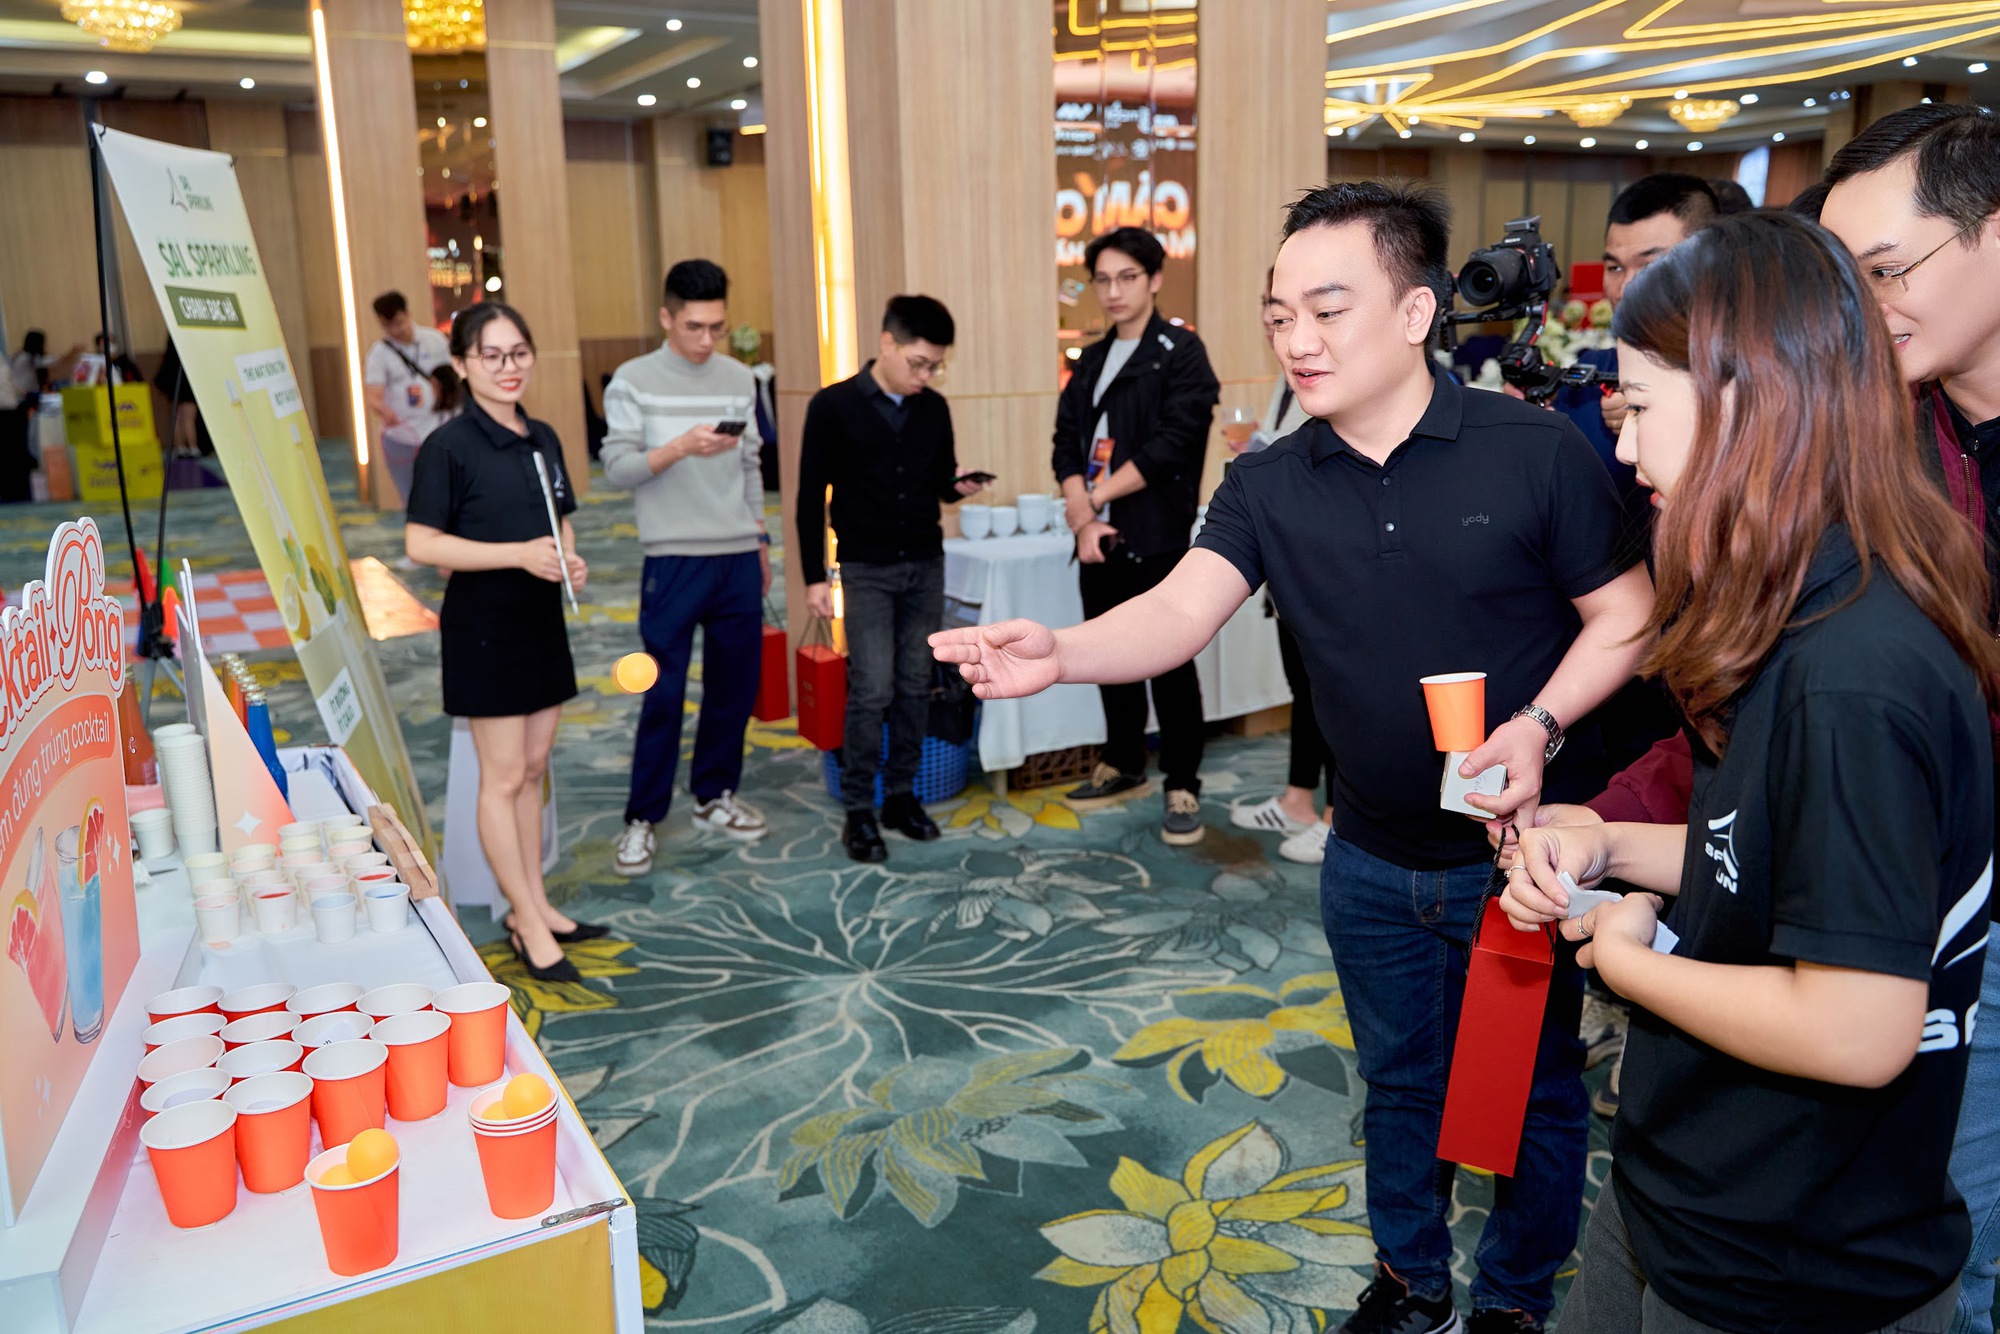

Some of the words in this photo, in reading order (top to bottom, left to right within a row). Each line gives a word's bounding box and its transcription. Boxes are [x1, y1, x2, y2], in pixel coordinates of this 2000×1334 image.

[158, 242, 193, 278] SAL
[187, 242, 257, 278] SPARKLING
[1461, 512, 1489, 527] yody
[56, 534, 120, 683] Pong
[12, 756, 42, 821] đúng
[40, 728, 70, 774] trúng
[71, 711, 110, 749] cocktail
